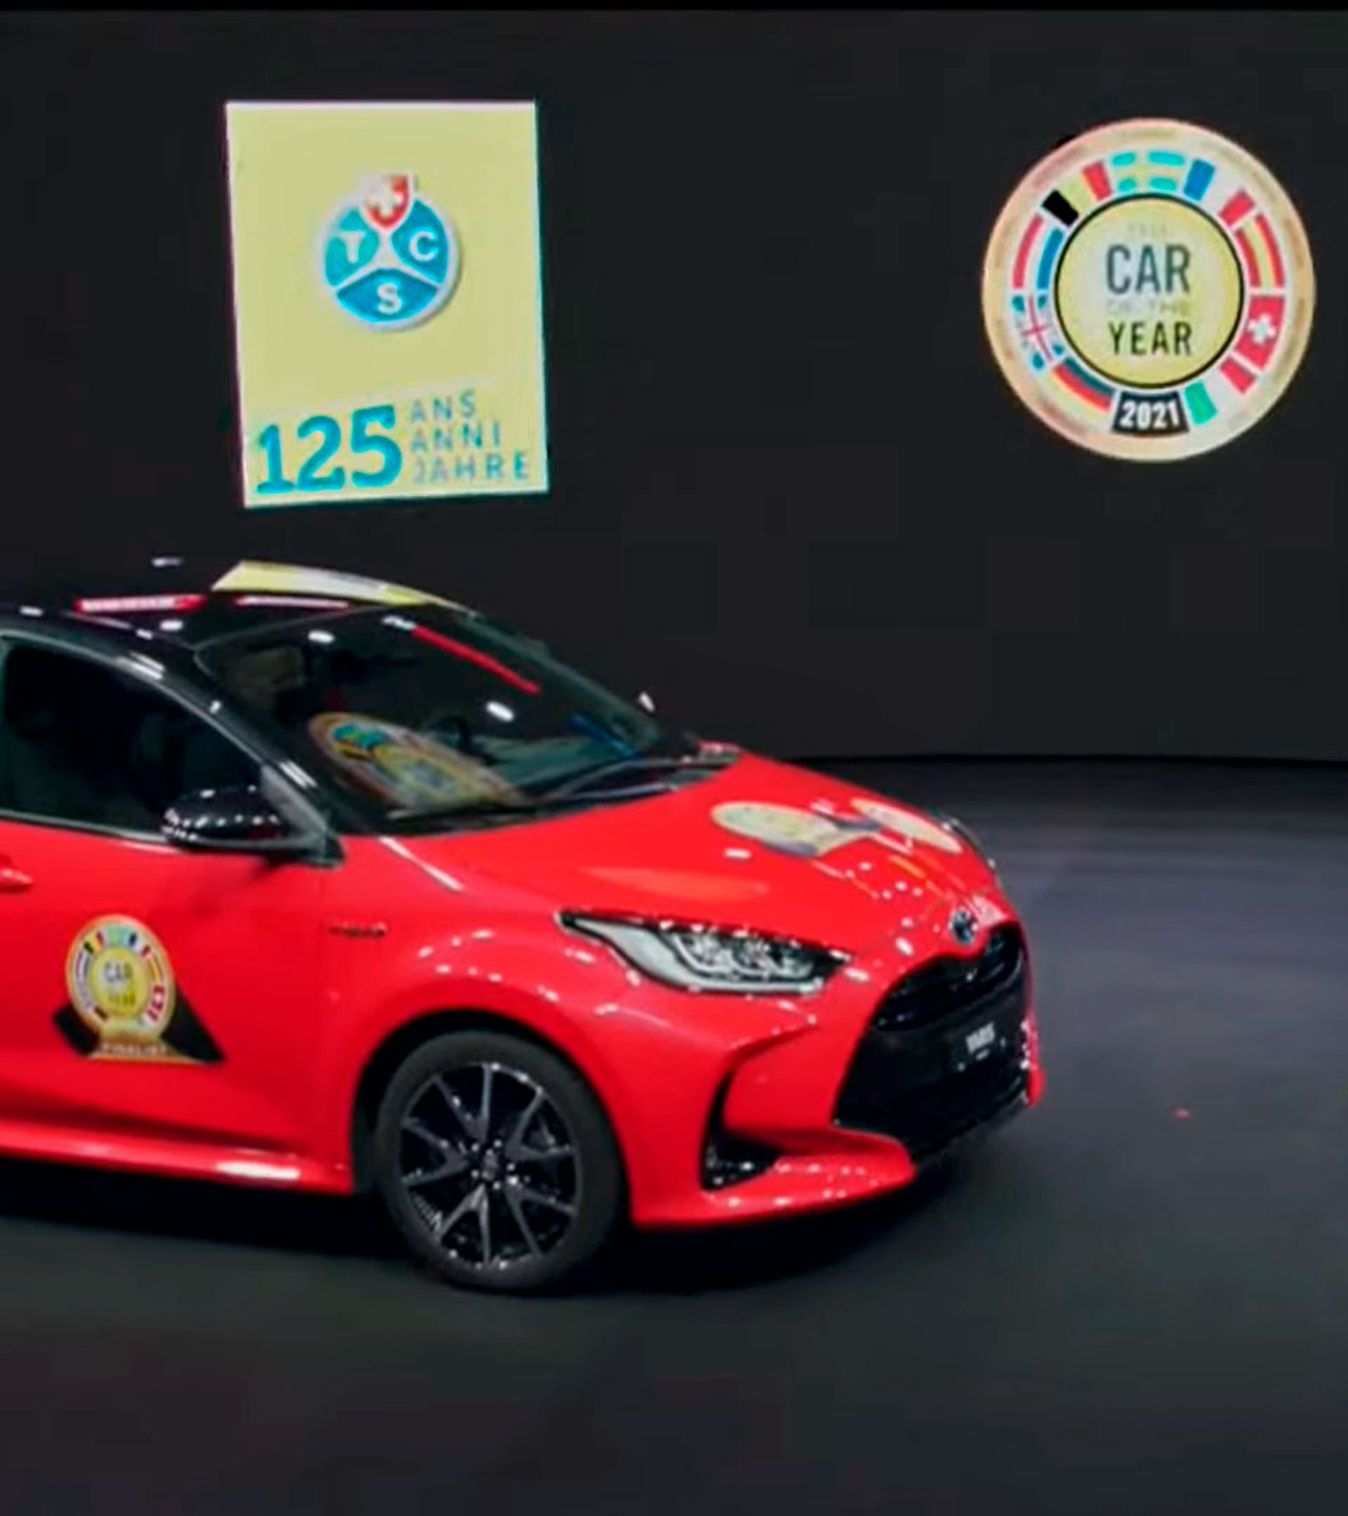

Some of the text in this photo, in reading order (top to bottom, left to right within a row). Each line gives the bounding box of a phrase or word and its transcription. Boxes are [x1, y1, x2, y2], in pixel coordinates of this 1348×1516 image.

[1106, 244, 1192, 295] CAR
[1108, 320, 1194, 357] YEAR
[409, 389, 476, 422] ANS
[1120, 400, 1182, 430] 2021
[256, 404, 502, 494] 125 ANNI
[411, 450, 530, 485] JAHRE
